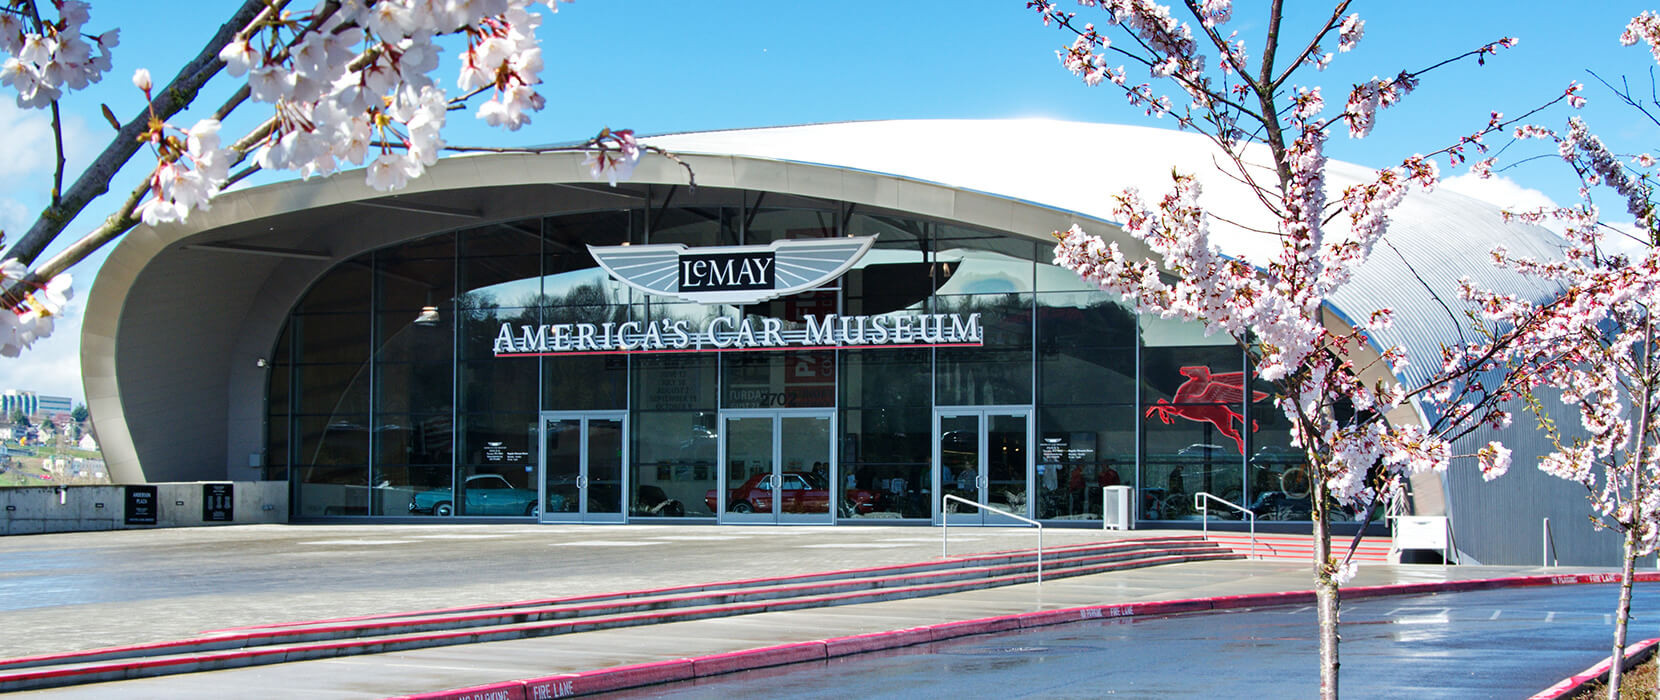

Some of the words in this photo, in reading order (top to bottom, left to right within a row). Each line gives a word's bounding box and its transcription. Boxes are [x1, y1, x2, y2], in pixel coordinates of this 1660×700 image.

[682, 257, 773, 287] LeMAY
[707, 316, 789, 348] CAR
[802, 312, 982, 346] MUSEUM
[760, 393, 797, 407] 2702
[533, 685, 551, 700] FIRE
[553, 681, 574, 697] LANE
